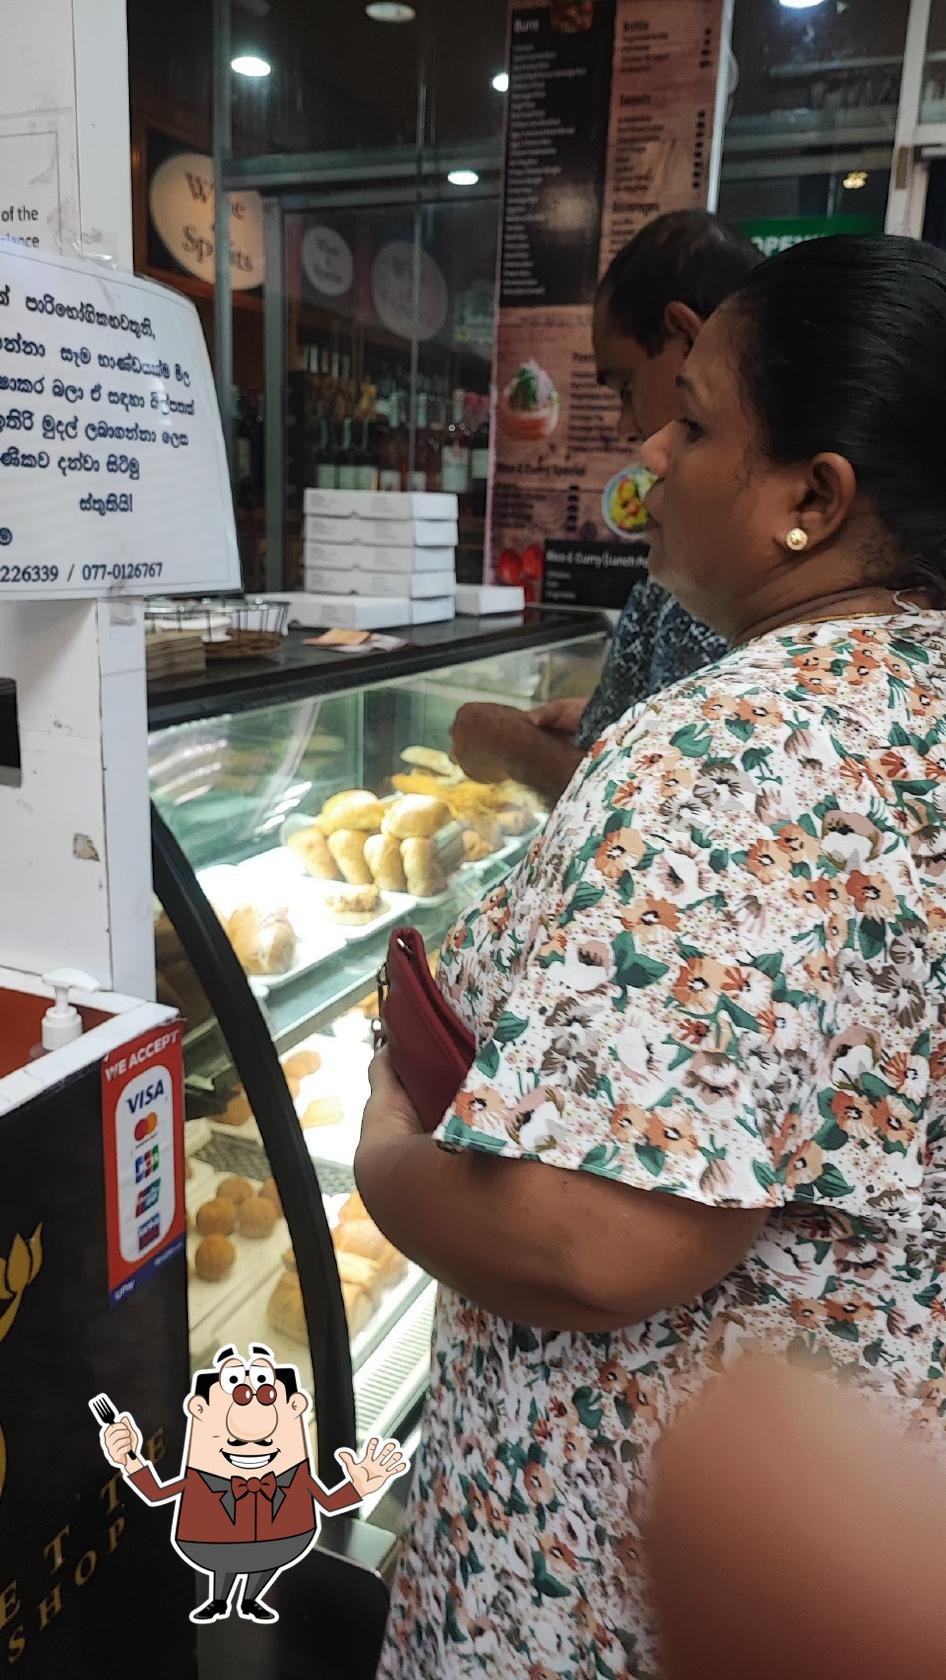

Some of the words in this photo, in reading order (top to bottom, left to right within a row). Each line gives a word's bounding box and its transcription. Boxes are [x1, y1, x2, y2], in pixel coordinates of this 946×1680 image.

[184, 168, 246, 220] We
[1, 205, 14, 222] of
[18, 205, 39, 221] the
[52, 378, 84, 403] බලා
[67, 563, 75, 582] /
[82, 562, 163, 581] 077-0126767
[105, 1059, 127, 1082] WE
[128, 1029, 179, 1067] ACCEPT
[126, 1079, 165, 1115] VISA
